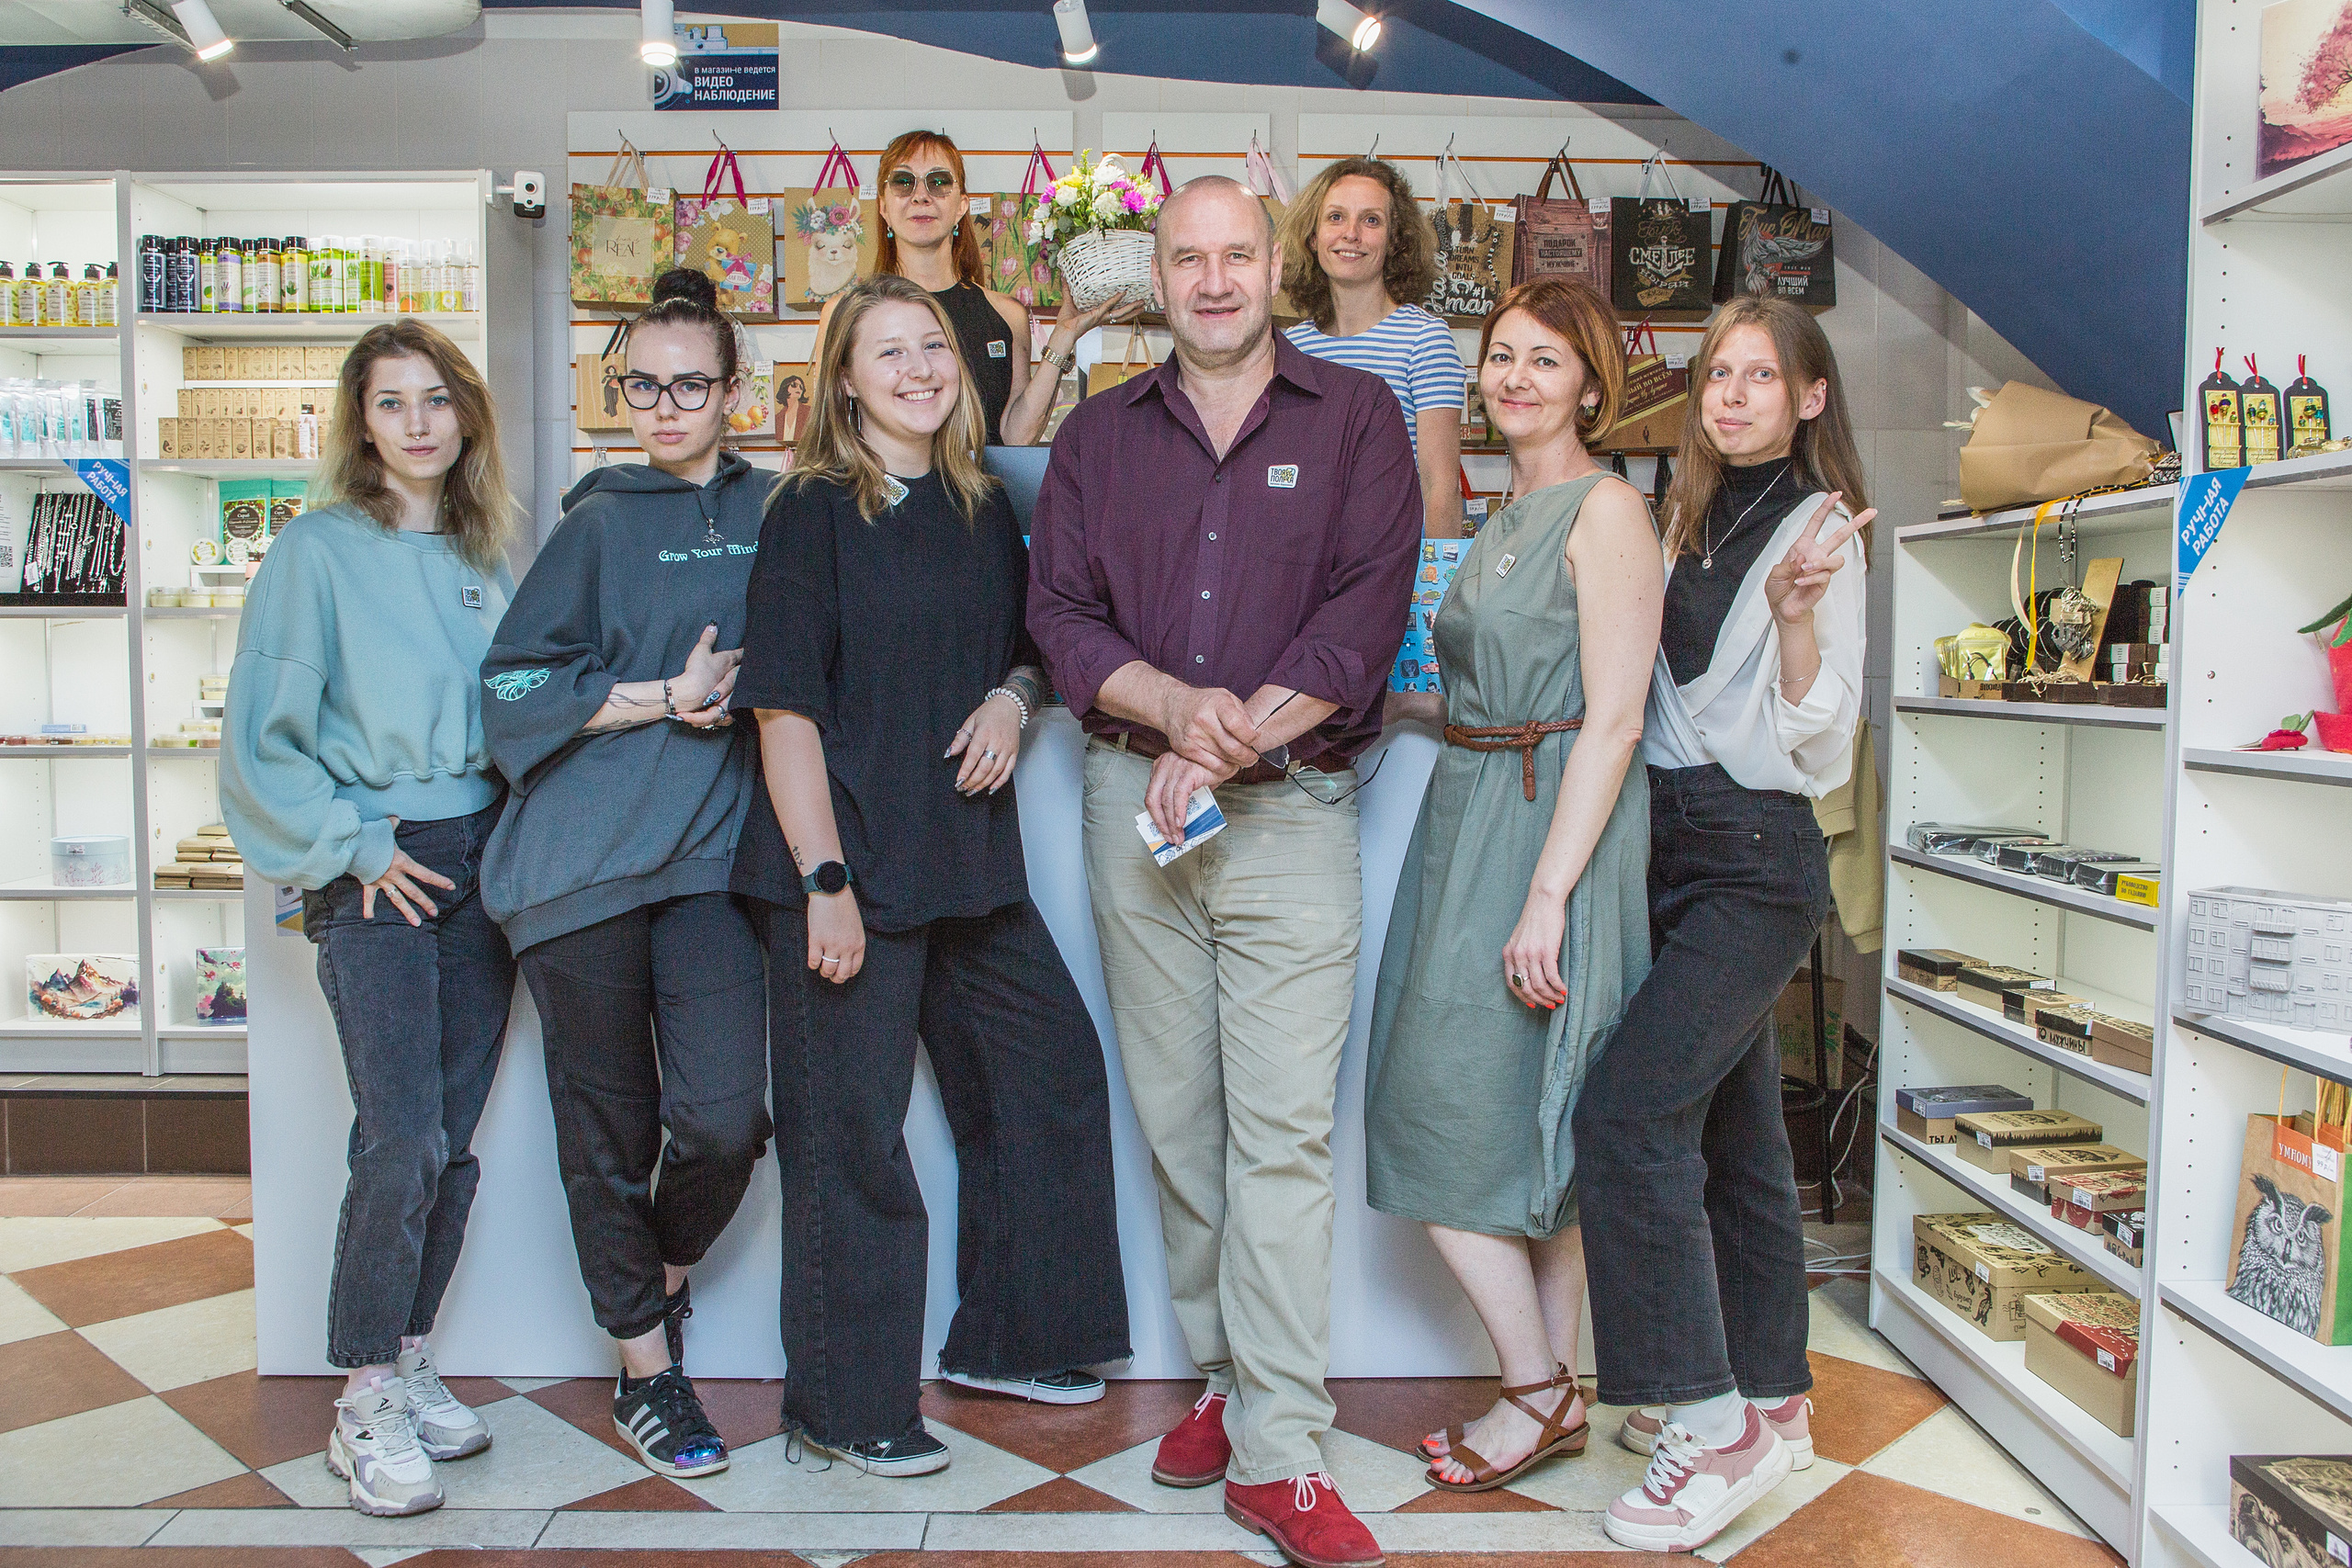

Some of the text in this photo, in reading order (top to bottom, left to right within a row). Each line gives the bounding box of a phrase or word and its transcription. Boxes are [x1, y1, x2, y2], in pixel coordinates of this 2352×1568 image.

[744, 66, 776, 74] ведется
[695, 76, 733, 89] ВИДЕО
[695, 89, 775, 103] НАБЛЮДЕНИЕ
[1544, 239, 1577, 248] ПОДАРОК
[1778, 275, 1808, 287] ЛУЧШИЙ
[93, 461, 128, 497] РУЧНАЯ
[87, 471, 118, 504] РАБОТА
[2181, 477, 2222, 546] РУЧНАЯ
[2192, 497, 2230, 557] РАБОТА
[659, 550, 687, 562] Grow
[691, 547, 723, 558] Your
[2049, 1032, 2086, 1054] МУЖЧИНЫ
[1929, 1134, 1944, 1144] ТЫ
